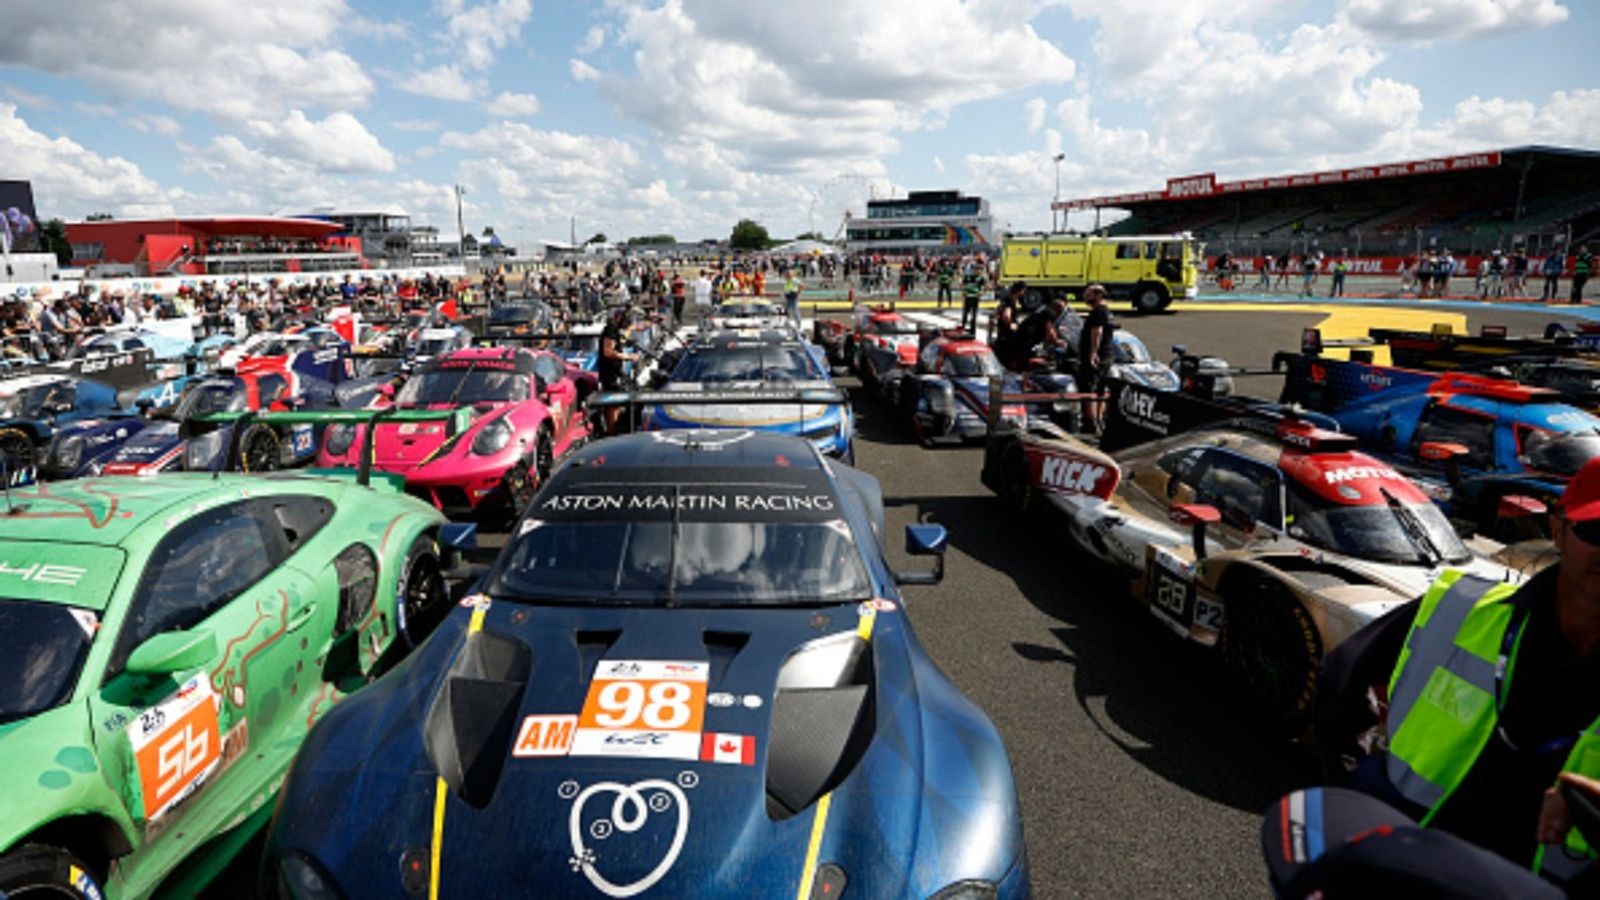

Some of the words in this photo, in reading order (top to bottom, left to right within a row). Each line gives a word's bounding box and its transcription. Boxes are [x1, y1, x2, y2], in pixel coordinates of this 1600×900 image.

[1168, 177, 1214, 197] MOTUL
[1041, 455, 1106, 493] KICK
[542, 495, 624, 510] ASTON
[627, 495, 726, 510] MARTIN
[734, 494, 835, 511] RACING
[1158, 575, 1187, 615] 28
[1196, 601, 1222, 628] P2
[595, 682, 692, 729] 98
[519, 721, 572, 750] AM
[155, 723, 208, 799] 56
